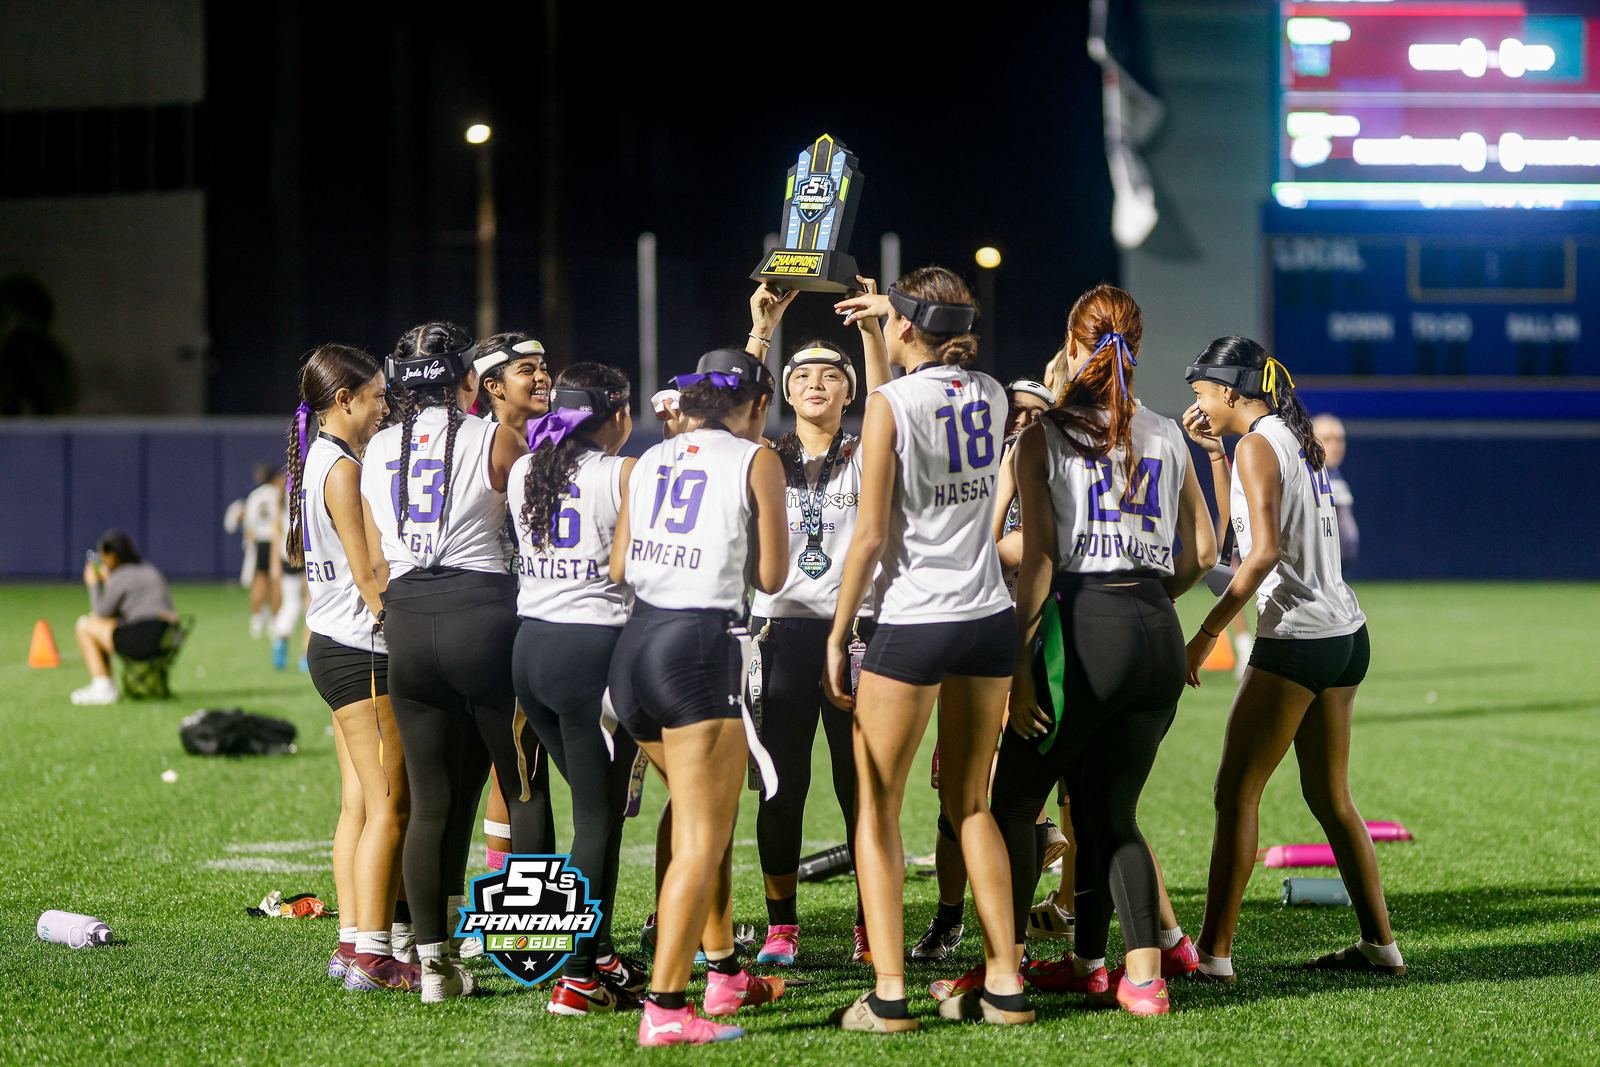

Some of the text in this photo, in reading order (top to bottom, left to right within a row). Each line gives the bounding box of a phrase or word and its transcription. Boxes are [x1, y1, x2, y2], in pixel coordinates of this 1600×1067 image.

[770, 254, 819, 270] CHAMPIONS
[423, 360, 446, 380] Vega
[935, 400, 995, 474] 18
[385, 458, 446, 523] 13
[649, 465, 708, 534] 19
[1084, 453, 1163, 533] 24
[518, 556, 601, 580] BATISTA
